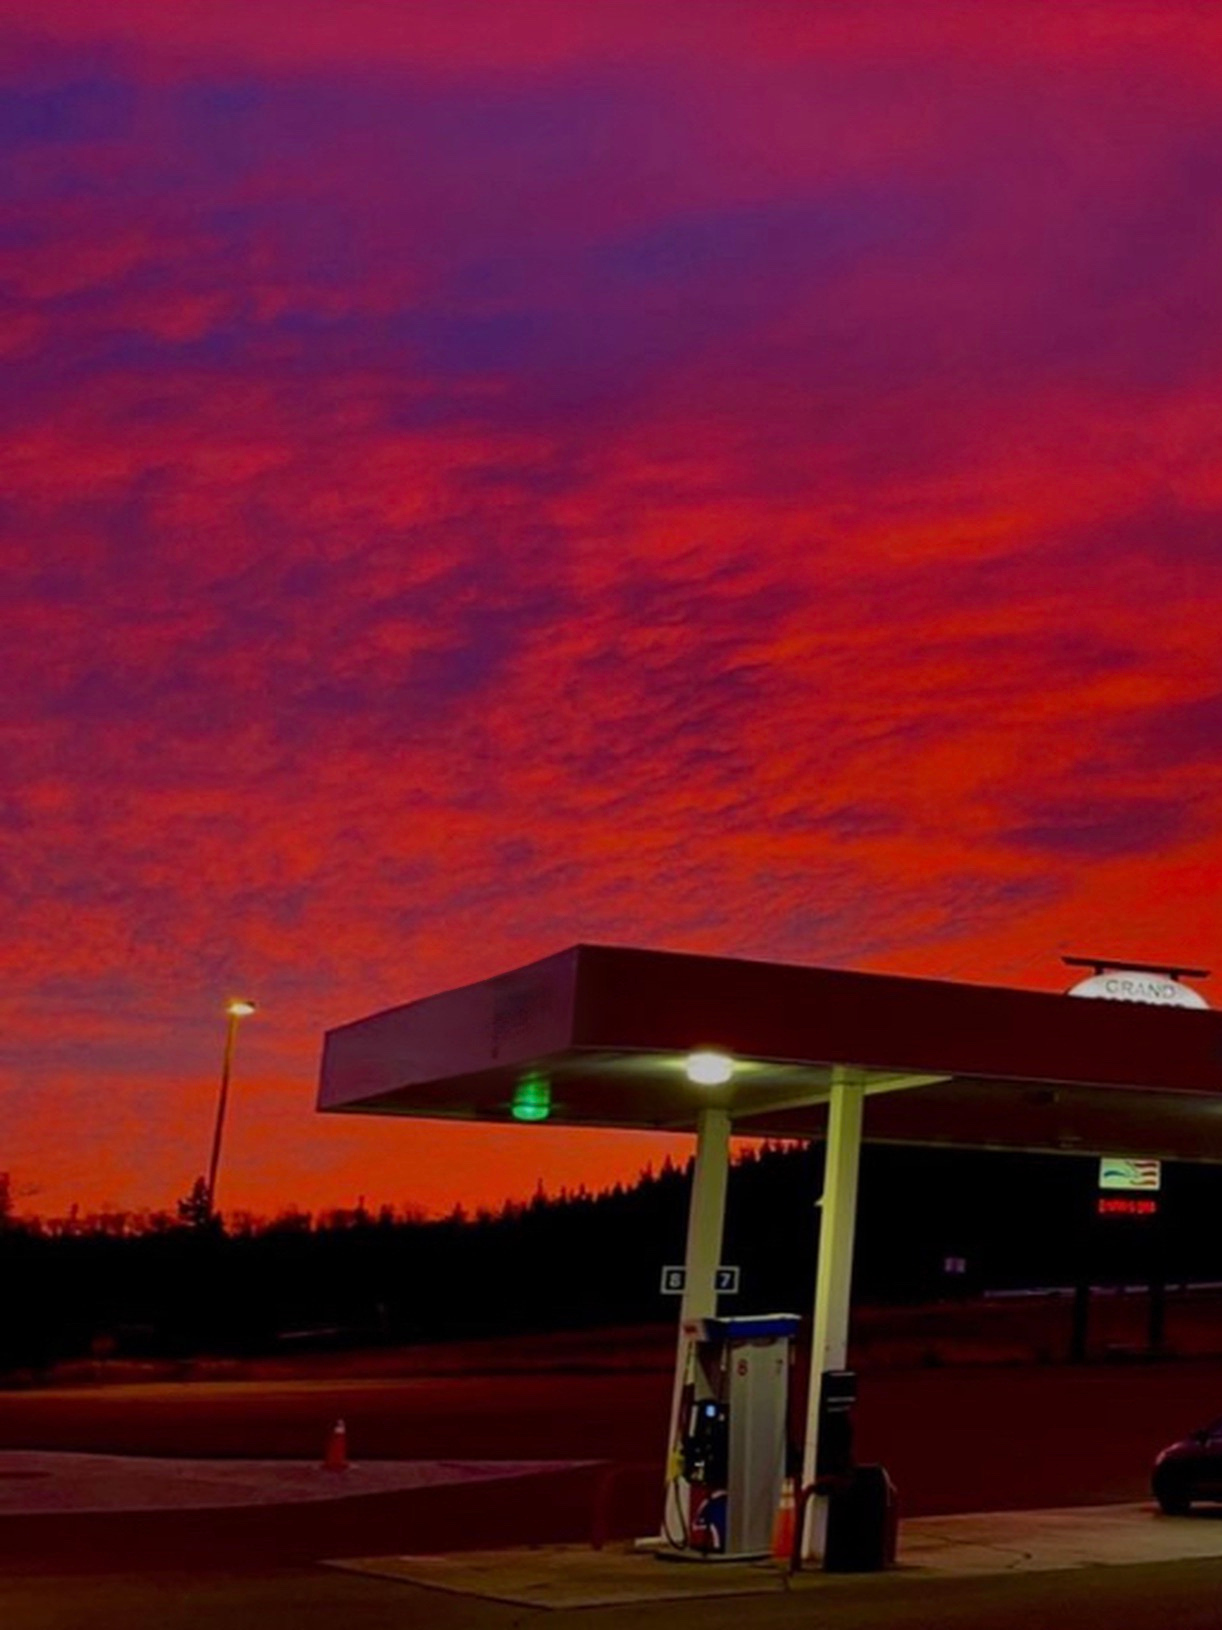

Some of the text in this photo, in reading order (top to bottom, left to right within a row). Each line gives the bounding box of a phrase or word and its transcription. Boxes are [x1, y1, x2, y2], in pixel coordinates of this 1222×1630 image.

[1105, 979, 1176, 999] GRAND
[670, 1273, 731, 1287] 8 7
